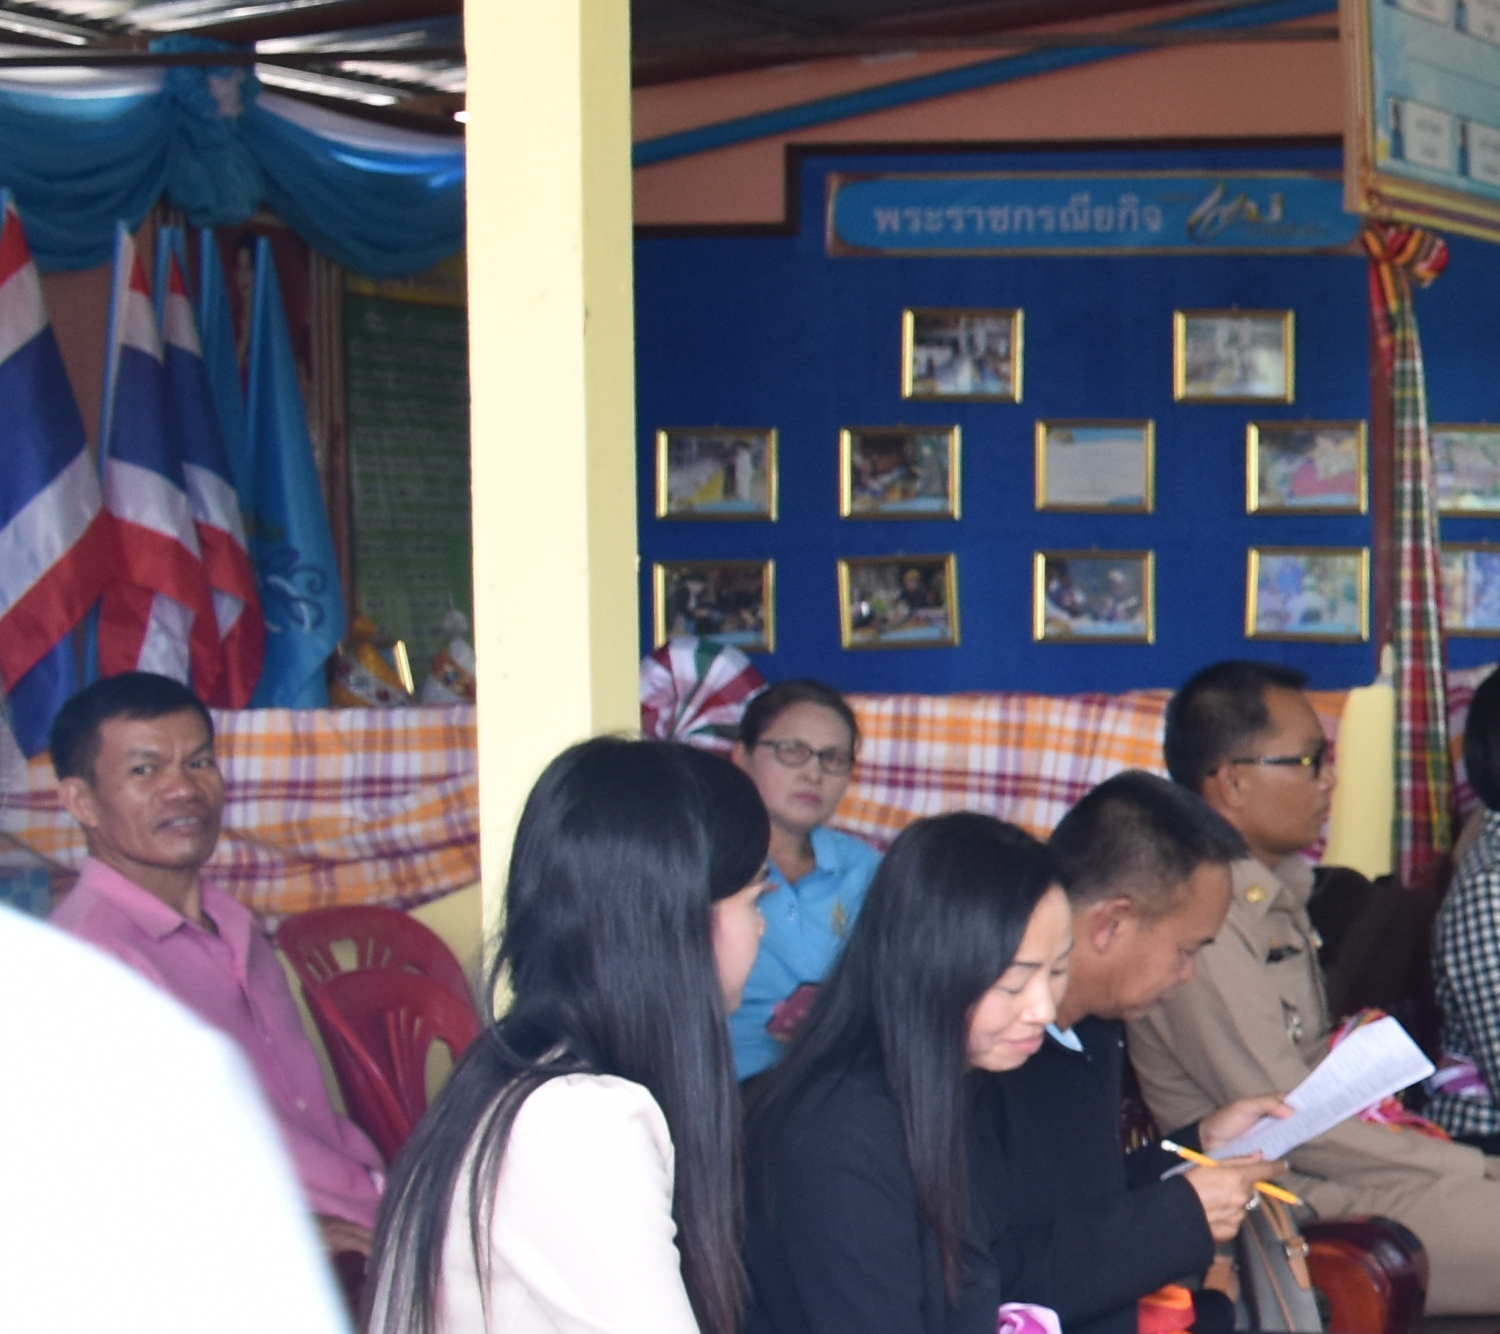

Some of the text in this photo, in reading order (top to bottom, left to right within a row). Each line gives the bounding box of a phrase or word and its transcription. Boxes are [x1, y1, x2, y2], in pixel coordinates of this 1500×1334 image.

[873, 193, 1164, 235] พระราชกรณียกิจ
